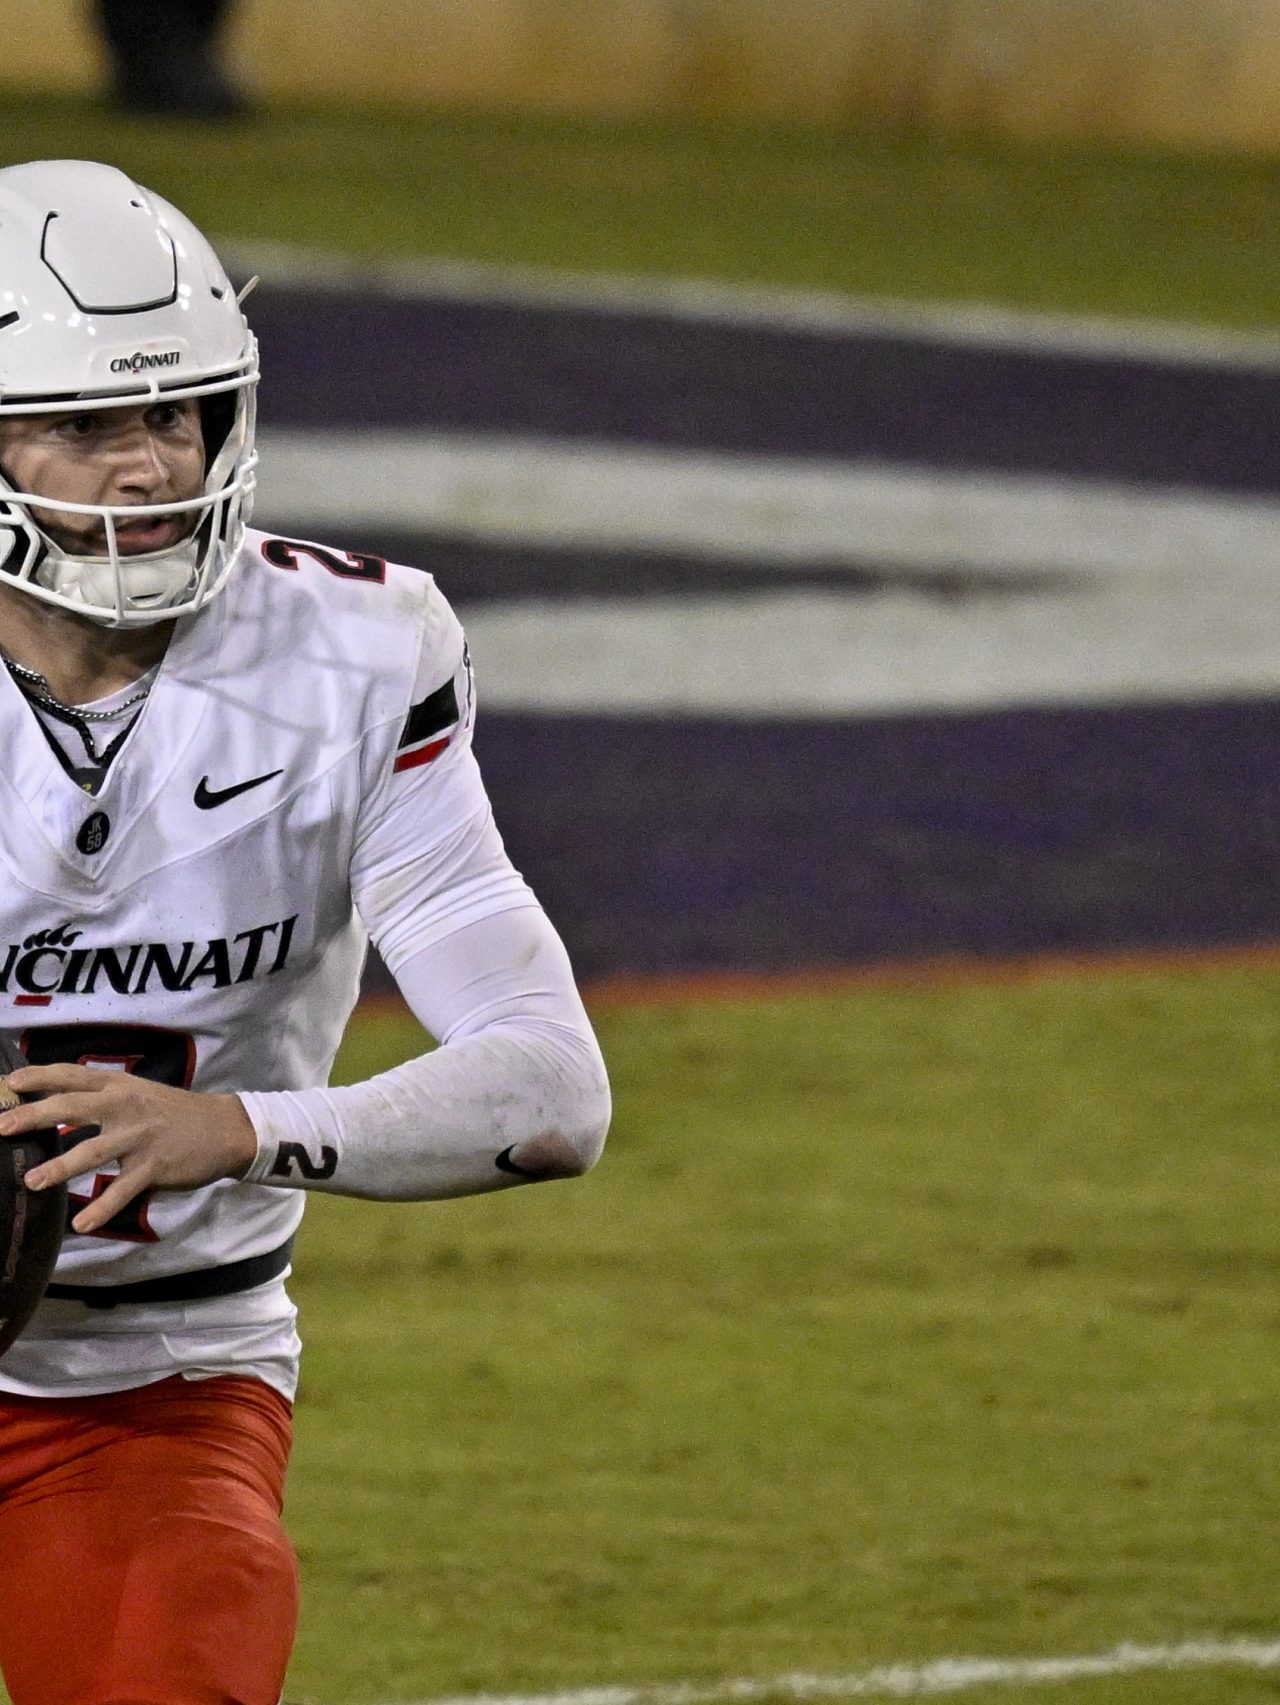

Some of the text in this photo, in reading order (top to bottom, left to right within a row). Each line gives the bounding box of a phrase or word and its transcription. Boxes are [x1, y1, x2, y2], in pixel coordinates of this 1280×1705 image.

[109, 351, 181, 374] CINCINNATI
[261, 539, 387, 585] 2
[88, 815, 103, 835] JK
[86, 832, 103, 851] 58
[268, 1140, 339, 1180] 2
